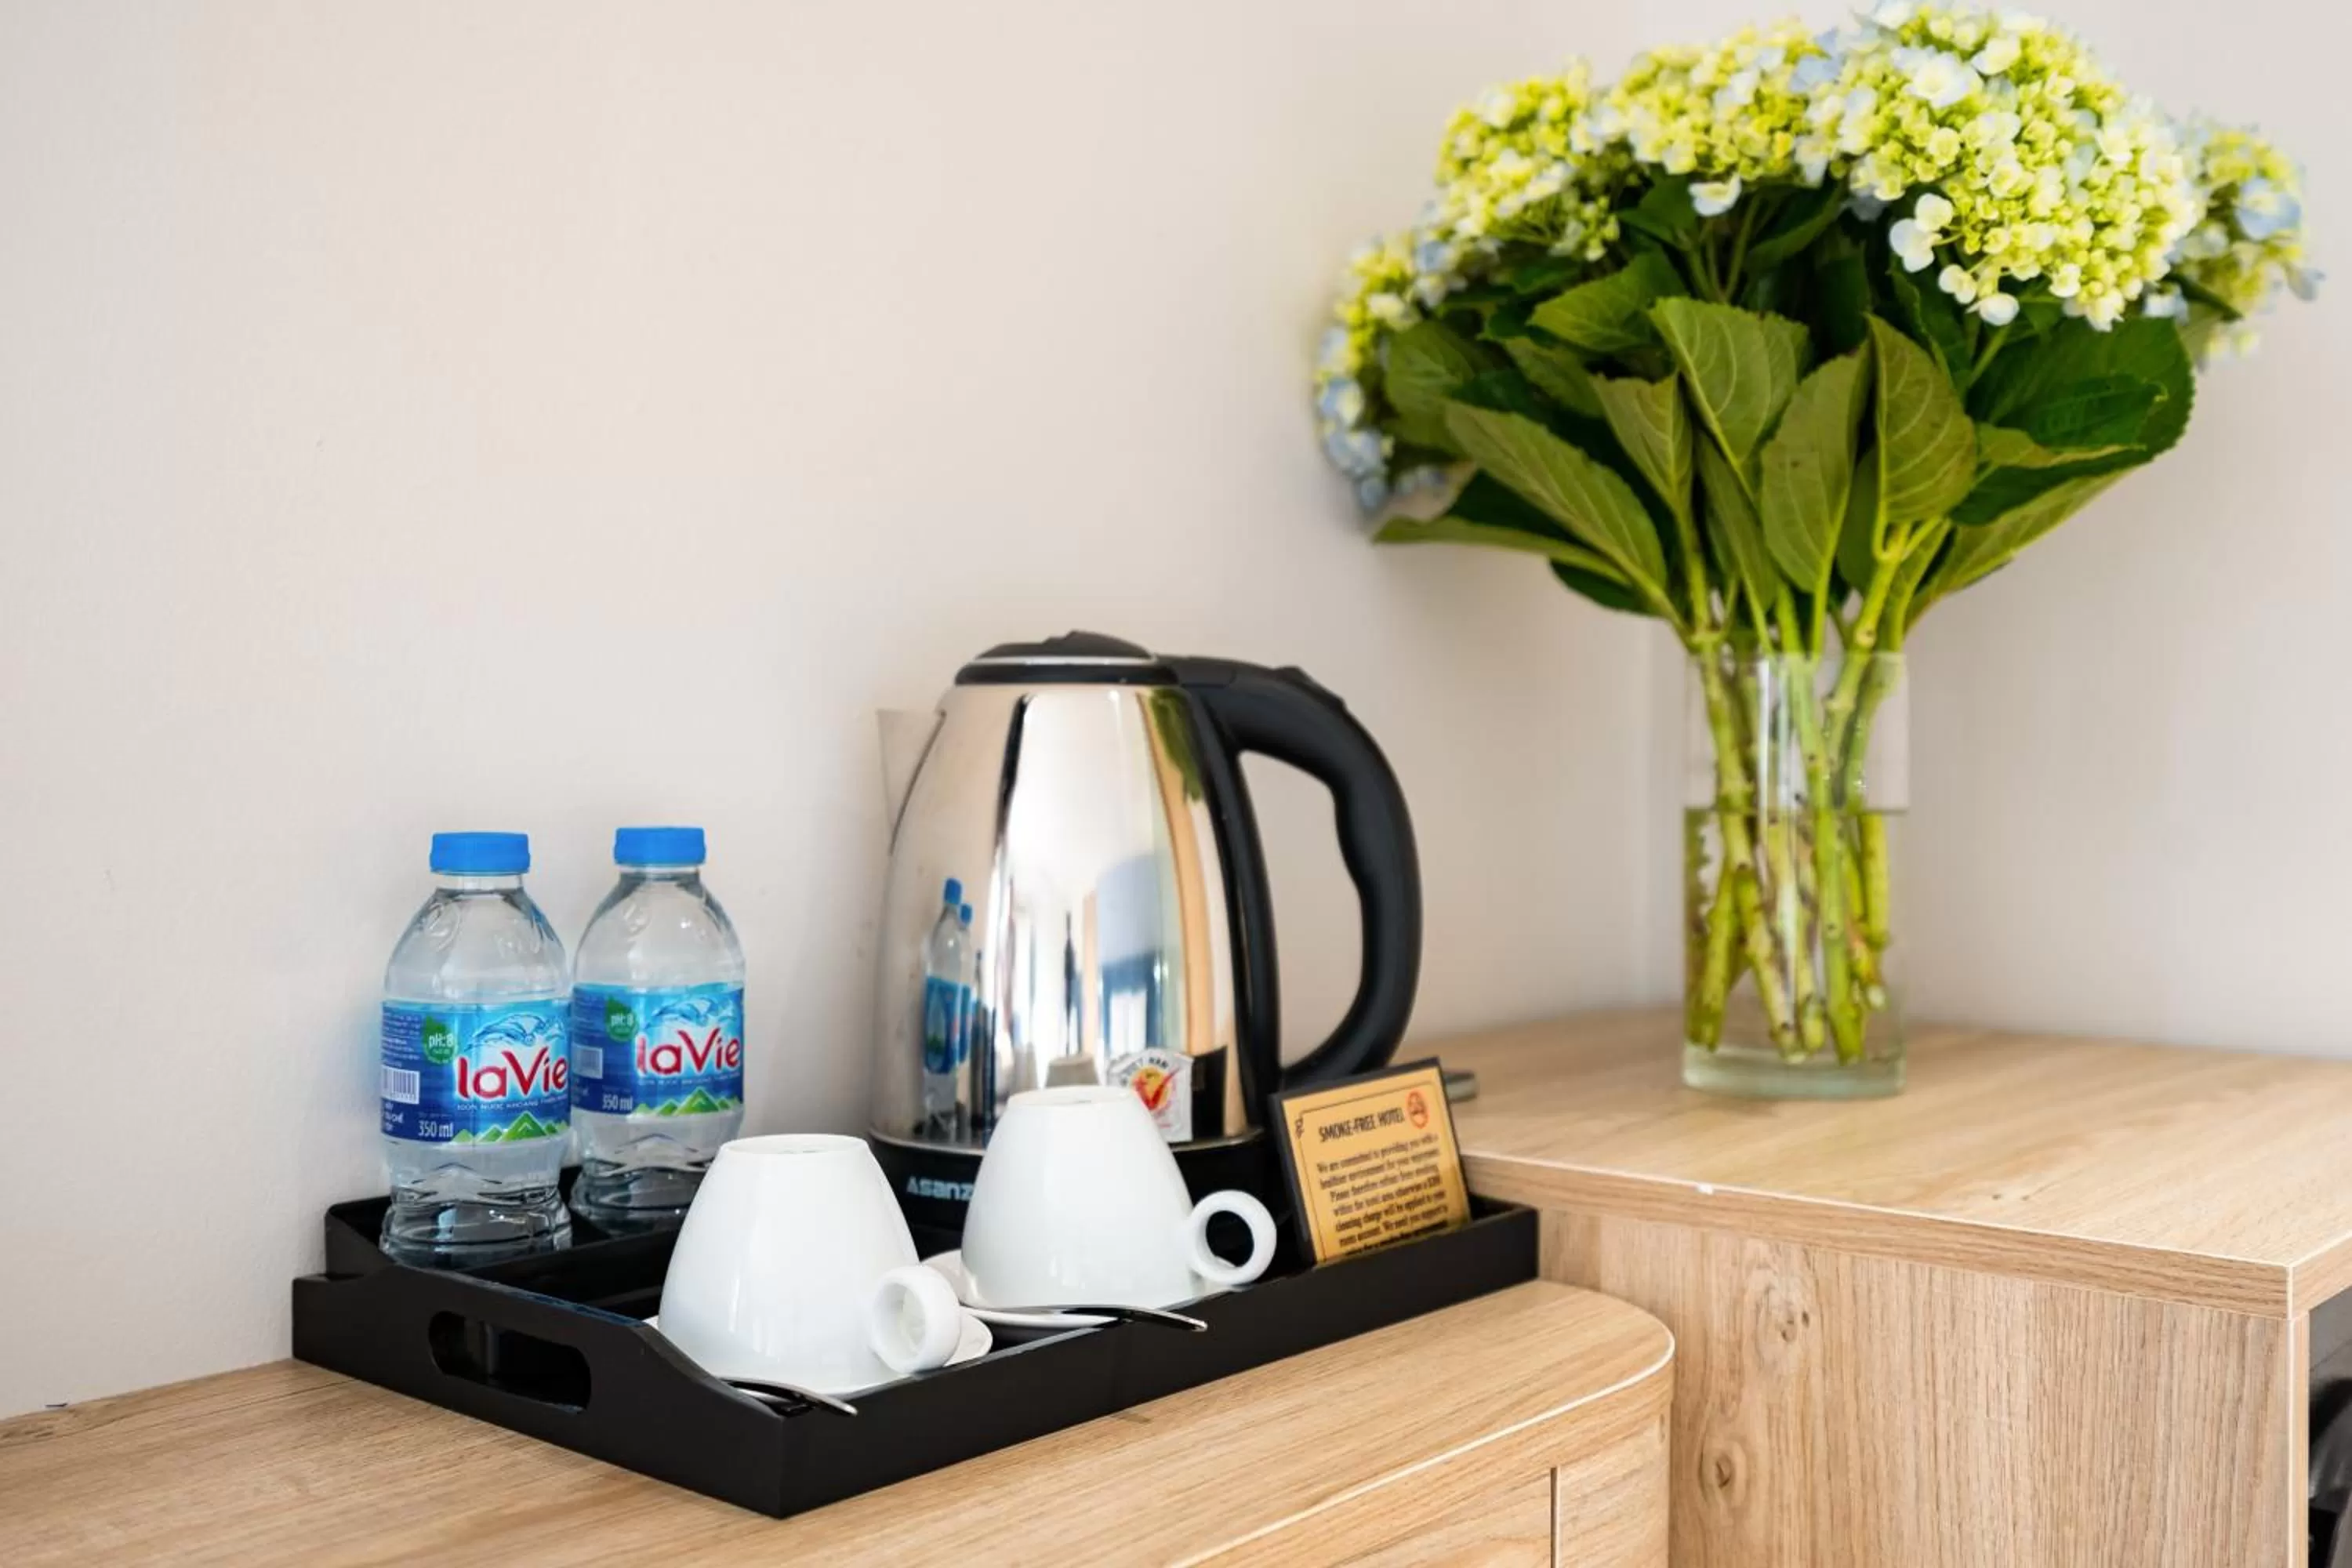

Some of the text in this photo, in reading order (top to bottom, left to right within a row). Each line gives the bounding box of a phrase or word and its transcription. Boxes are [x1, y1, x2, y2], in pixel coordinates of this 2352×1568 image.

[637, 1028, 741, 1076] laVie
[457, 1047, 568, 1099] laVie
[418, 1119, 455, 1138] 350 ml
[1319, 1107, 1405, 1142] SMOKE-FREE HOTEL
[906, 1176, 975, 1201] Asanz
